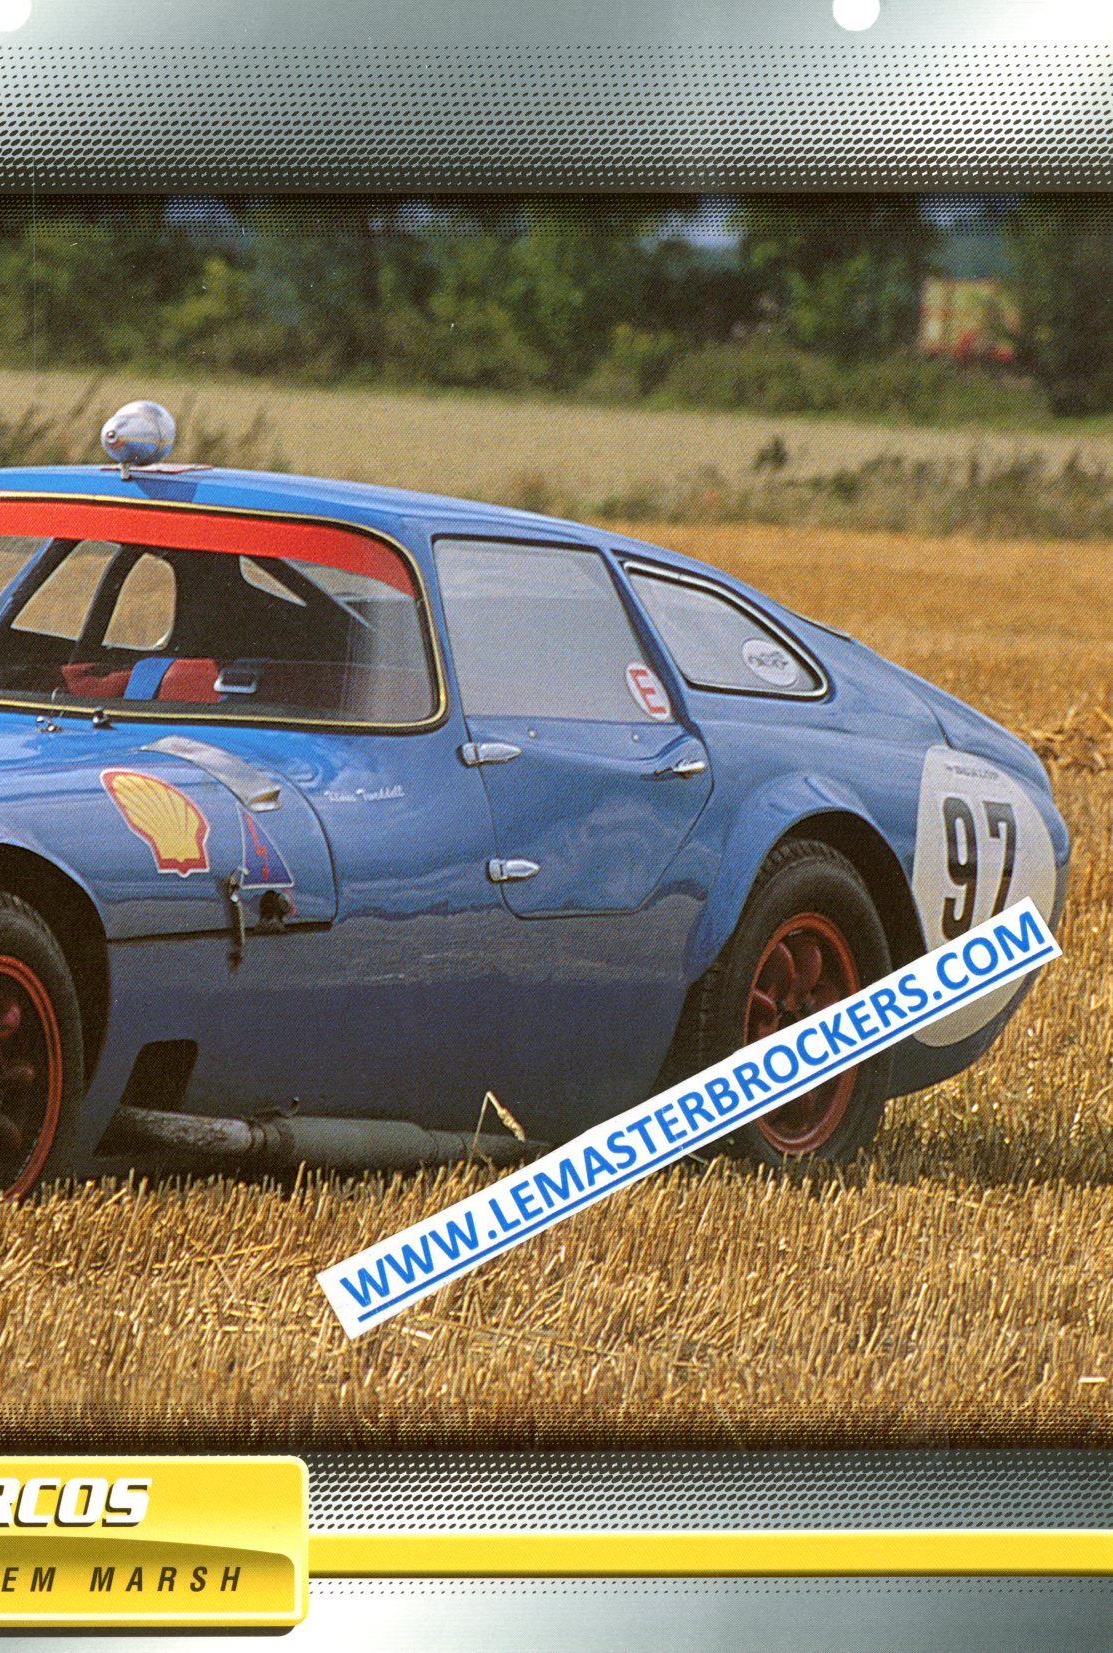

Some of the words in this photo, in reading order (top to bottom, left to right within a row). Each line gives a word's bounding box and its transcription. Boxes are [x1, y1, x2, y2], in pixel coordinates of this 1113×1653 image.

[629, 669, 667, 713] E
[941, 796, 1017, 941] 97
[89, 1566, 243, 1593] MARSH
